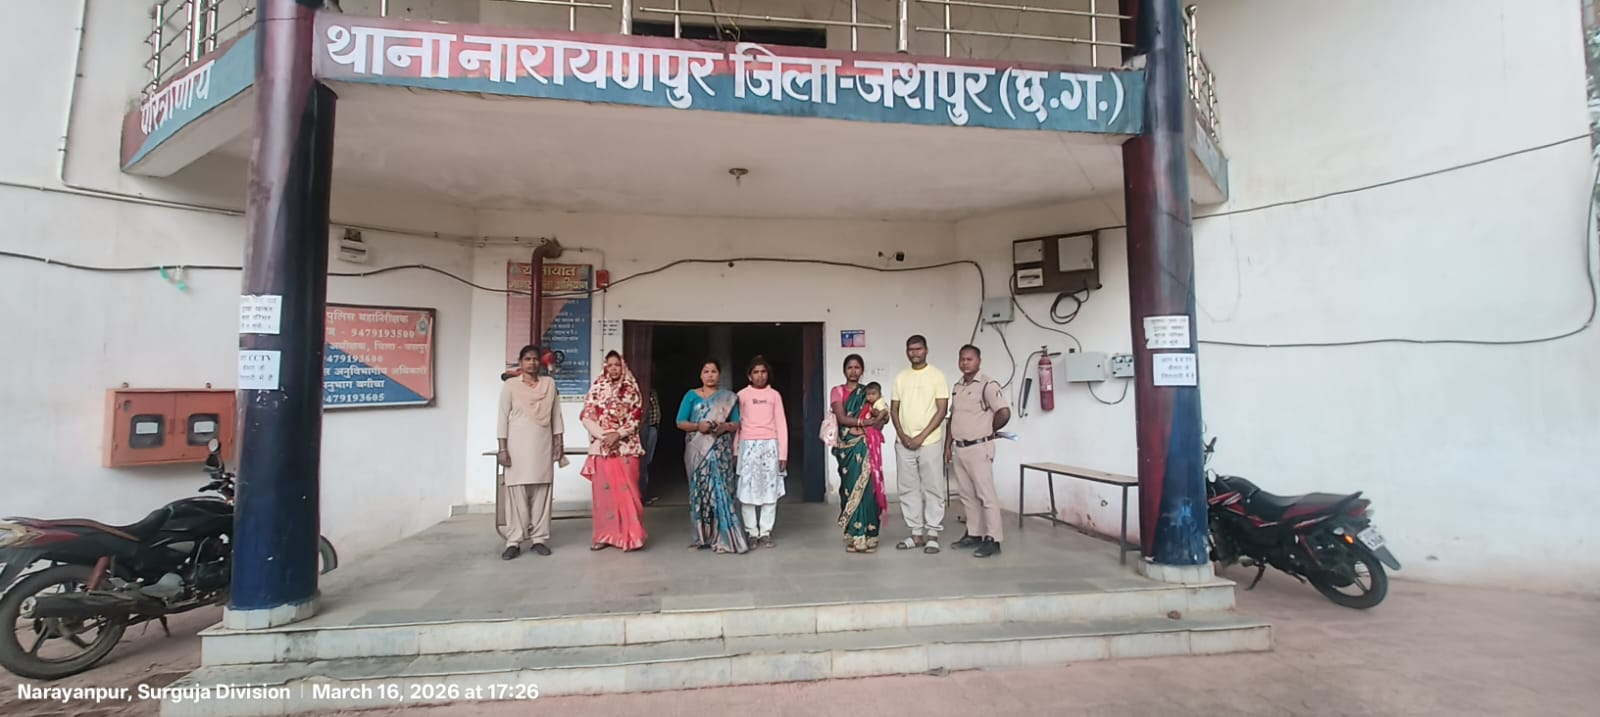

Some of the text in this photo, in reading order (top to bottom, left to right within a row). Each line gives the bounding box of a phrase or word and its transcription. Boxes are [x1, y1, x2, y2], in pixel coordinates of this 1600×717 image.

[326, 24, 456, 79] थाना
[458, 35, 724, 109] नारायणपुर
[999, 66, 1125, 126] (छ.ग.)
[324, 393, 385, 403] 479193605
